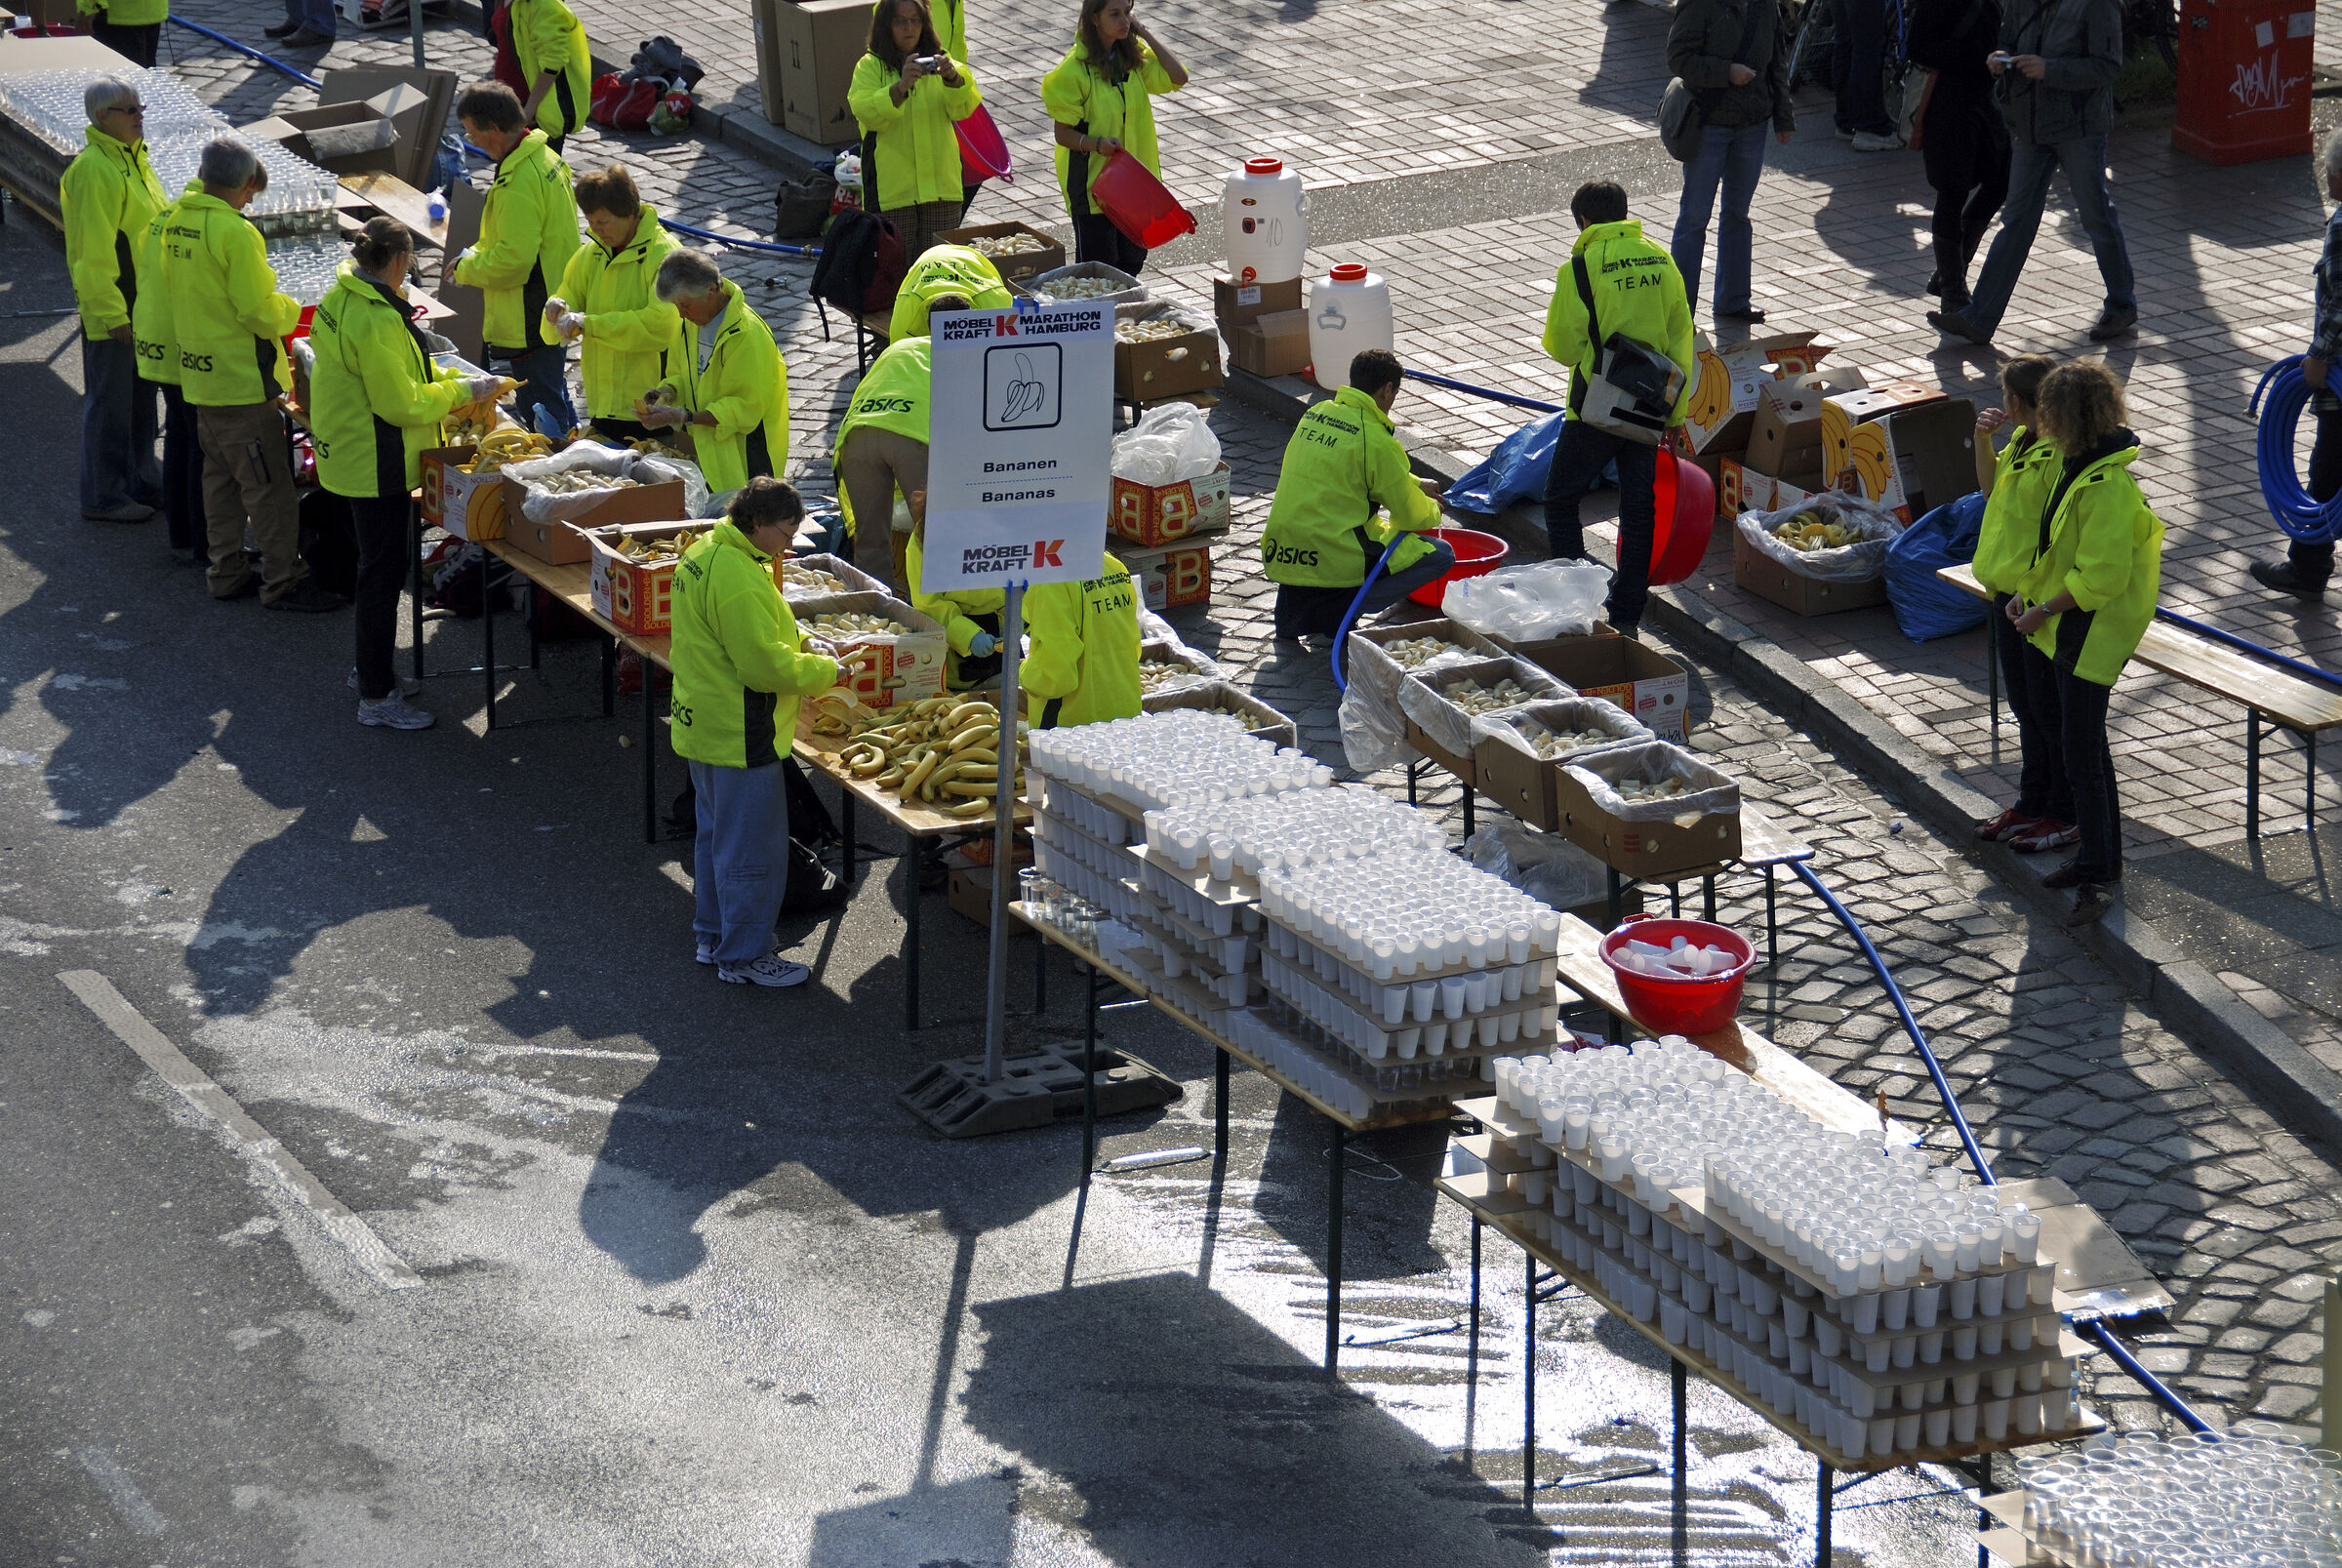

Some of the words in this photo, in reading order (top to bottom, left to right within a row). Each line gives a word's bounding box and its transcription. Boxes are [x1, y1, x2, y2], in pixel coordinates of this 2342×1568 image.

[944, 317, 995, 331] MÖBEL
[1020, 311, 1101, 325] MARATHON
[944, 328, 991, 341] KRAFT
[1025, 322, 1101, 335] HAMBURG
[1300, 427, 1338, 448] TEAM
[984, 460, 1057, 473] Bananen
[982, 489, 1056, 503] Bananas
[963, 544, 1032, 561] MÖBEL
[962, 558, 1028, 575] KRAFT
[1093, 593, 1133, 614] TEAM
[644, 620, 671, 630] GOLDE
[883, 648, 892, 677] GOLDE
